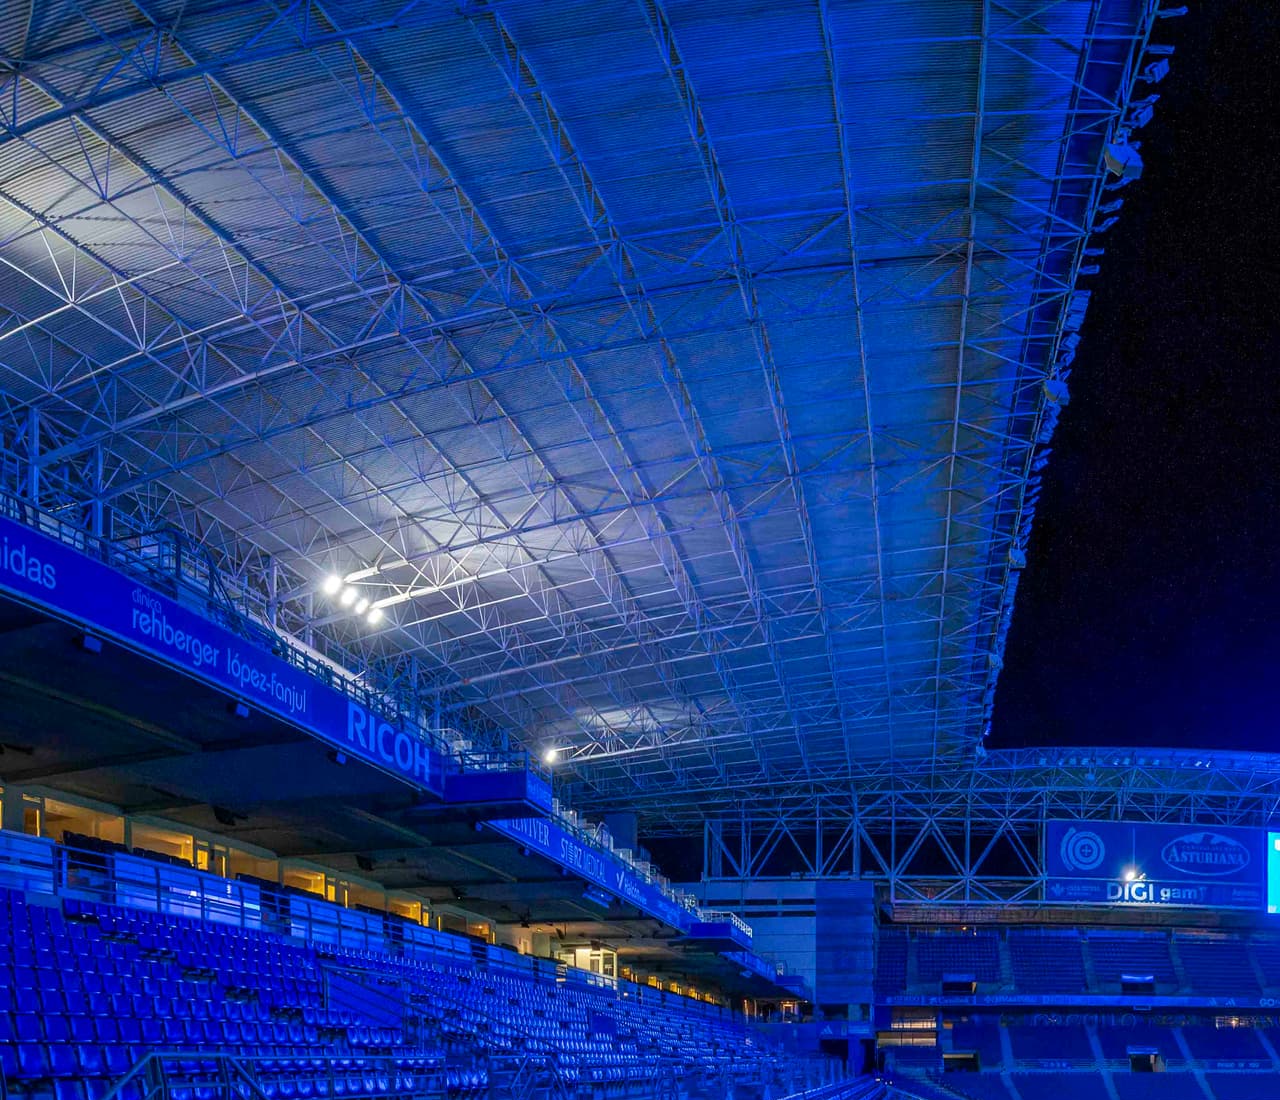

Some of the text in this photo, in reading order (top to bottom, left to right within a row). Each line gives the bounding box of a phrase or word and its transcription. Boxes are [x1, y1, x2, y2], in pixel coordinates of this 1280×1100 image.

[0, 536, 57, 590] idas
[131, 608, 307, 713] rehberger lópez-fanjul
[347, 700, 431, 784] RICOH
[1167, 845, 1245, 865] ASTURIANA
[1106, 881, 1154, 901] DIGI
